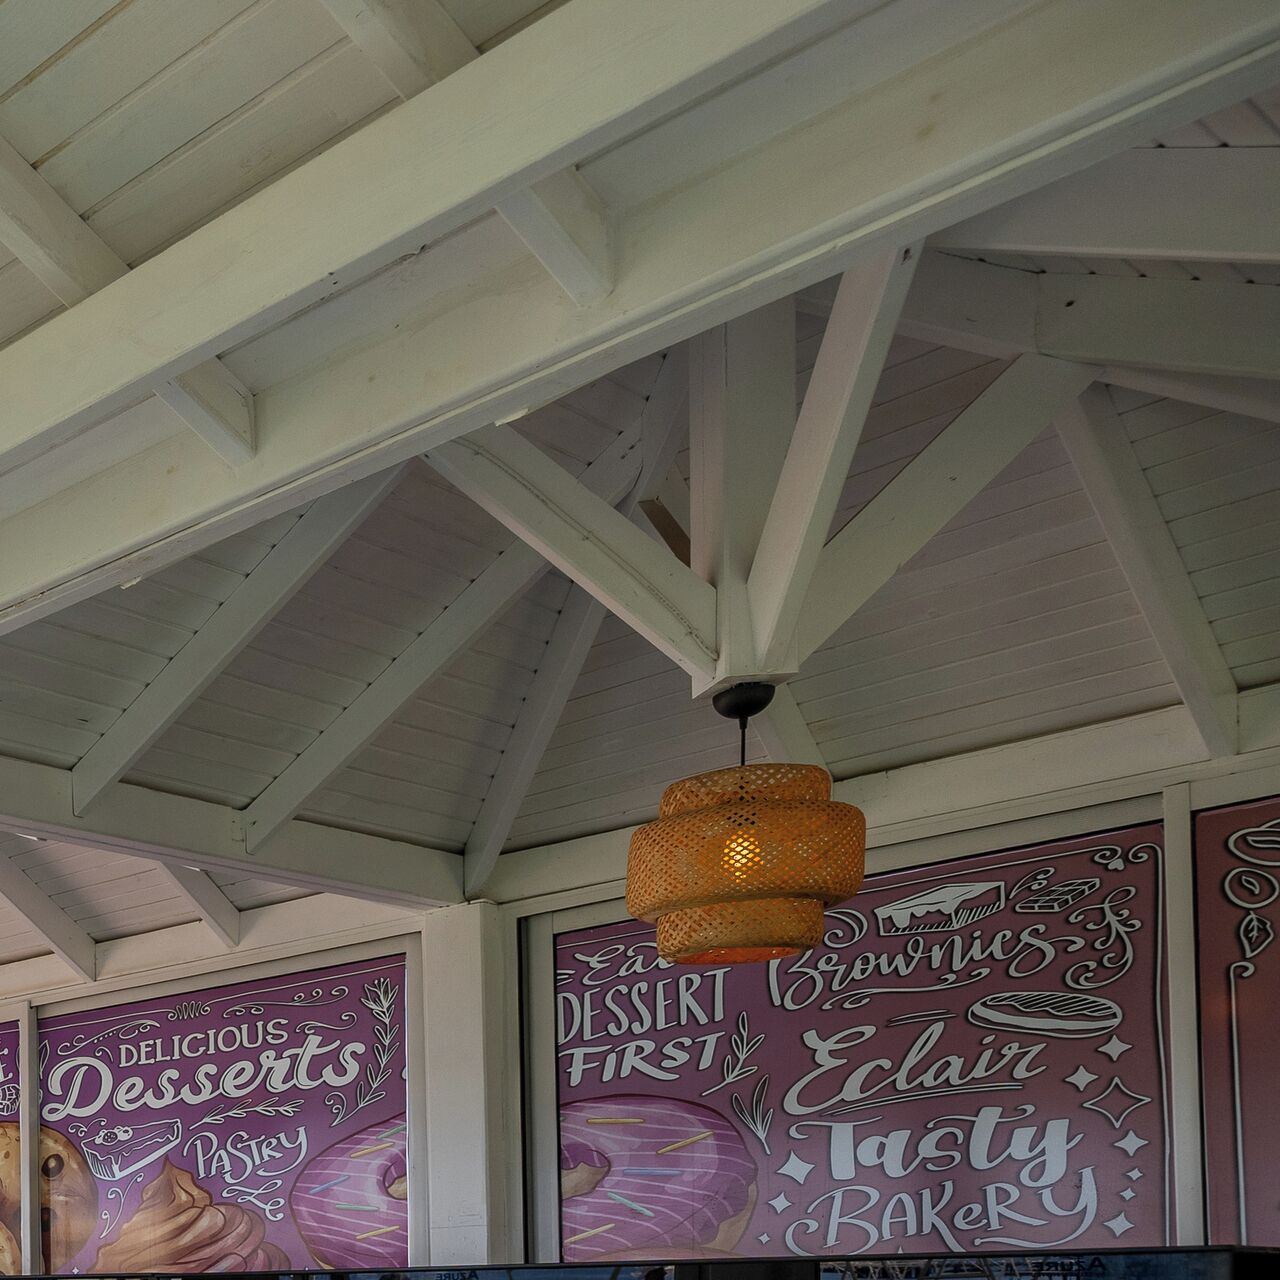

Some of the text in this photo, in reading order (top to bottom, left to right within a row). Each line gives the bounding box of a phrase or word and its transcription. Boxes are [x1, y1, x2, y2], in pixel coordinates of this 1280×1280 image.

[557, 968, 732, 1045] DESSERT
[769, 923, 1086, 1011] Brownies
[42, 1034, 366, 1121] Desserts
[119, 1019, 289, 1067] DELICIOUS
[558, 1032, 726, 1087] FIRST
[783, 1021, 1047, 1116] Eclair
[790, 1104, 1085, 1188] Tasty
